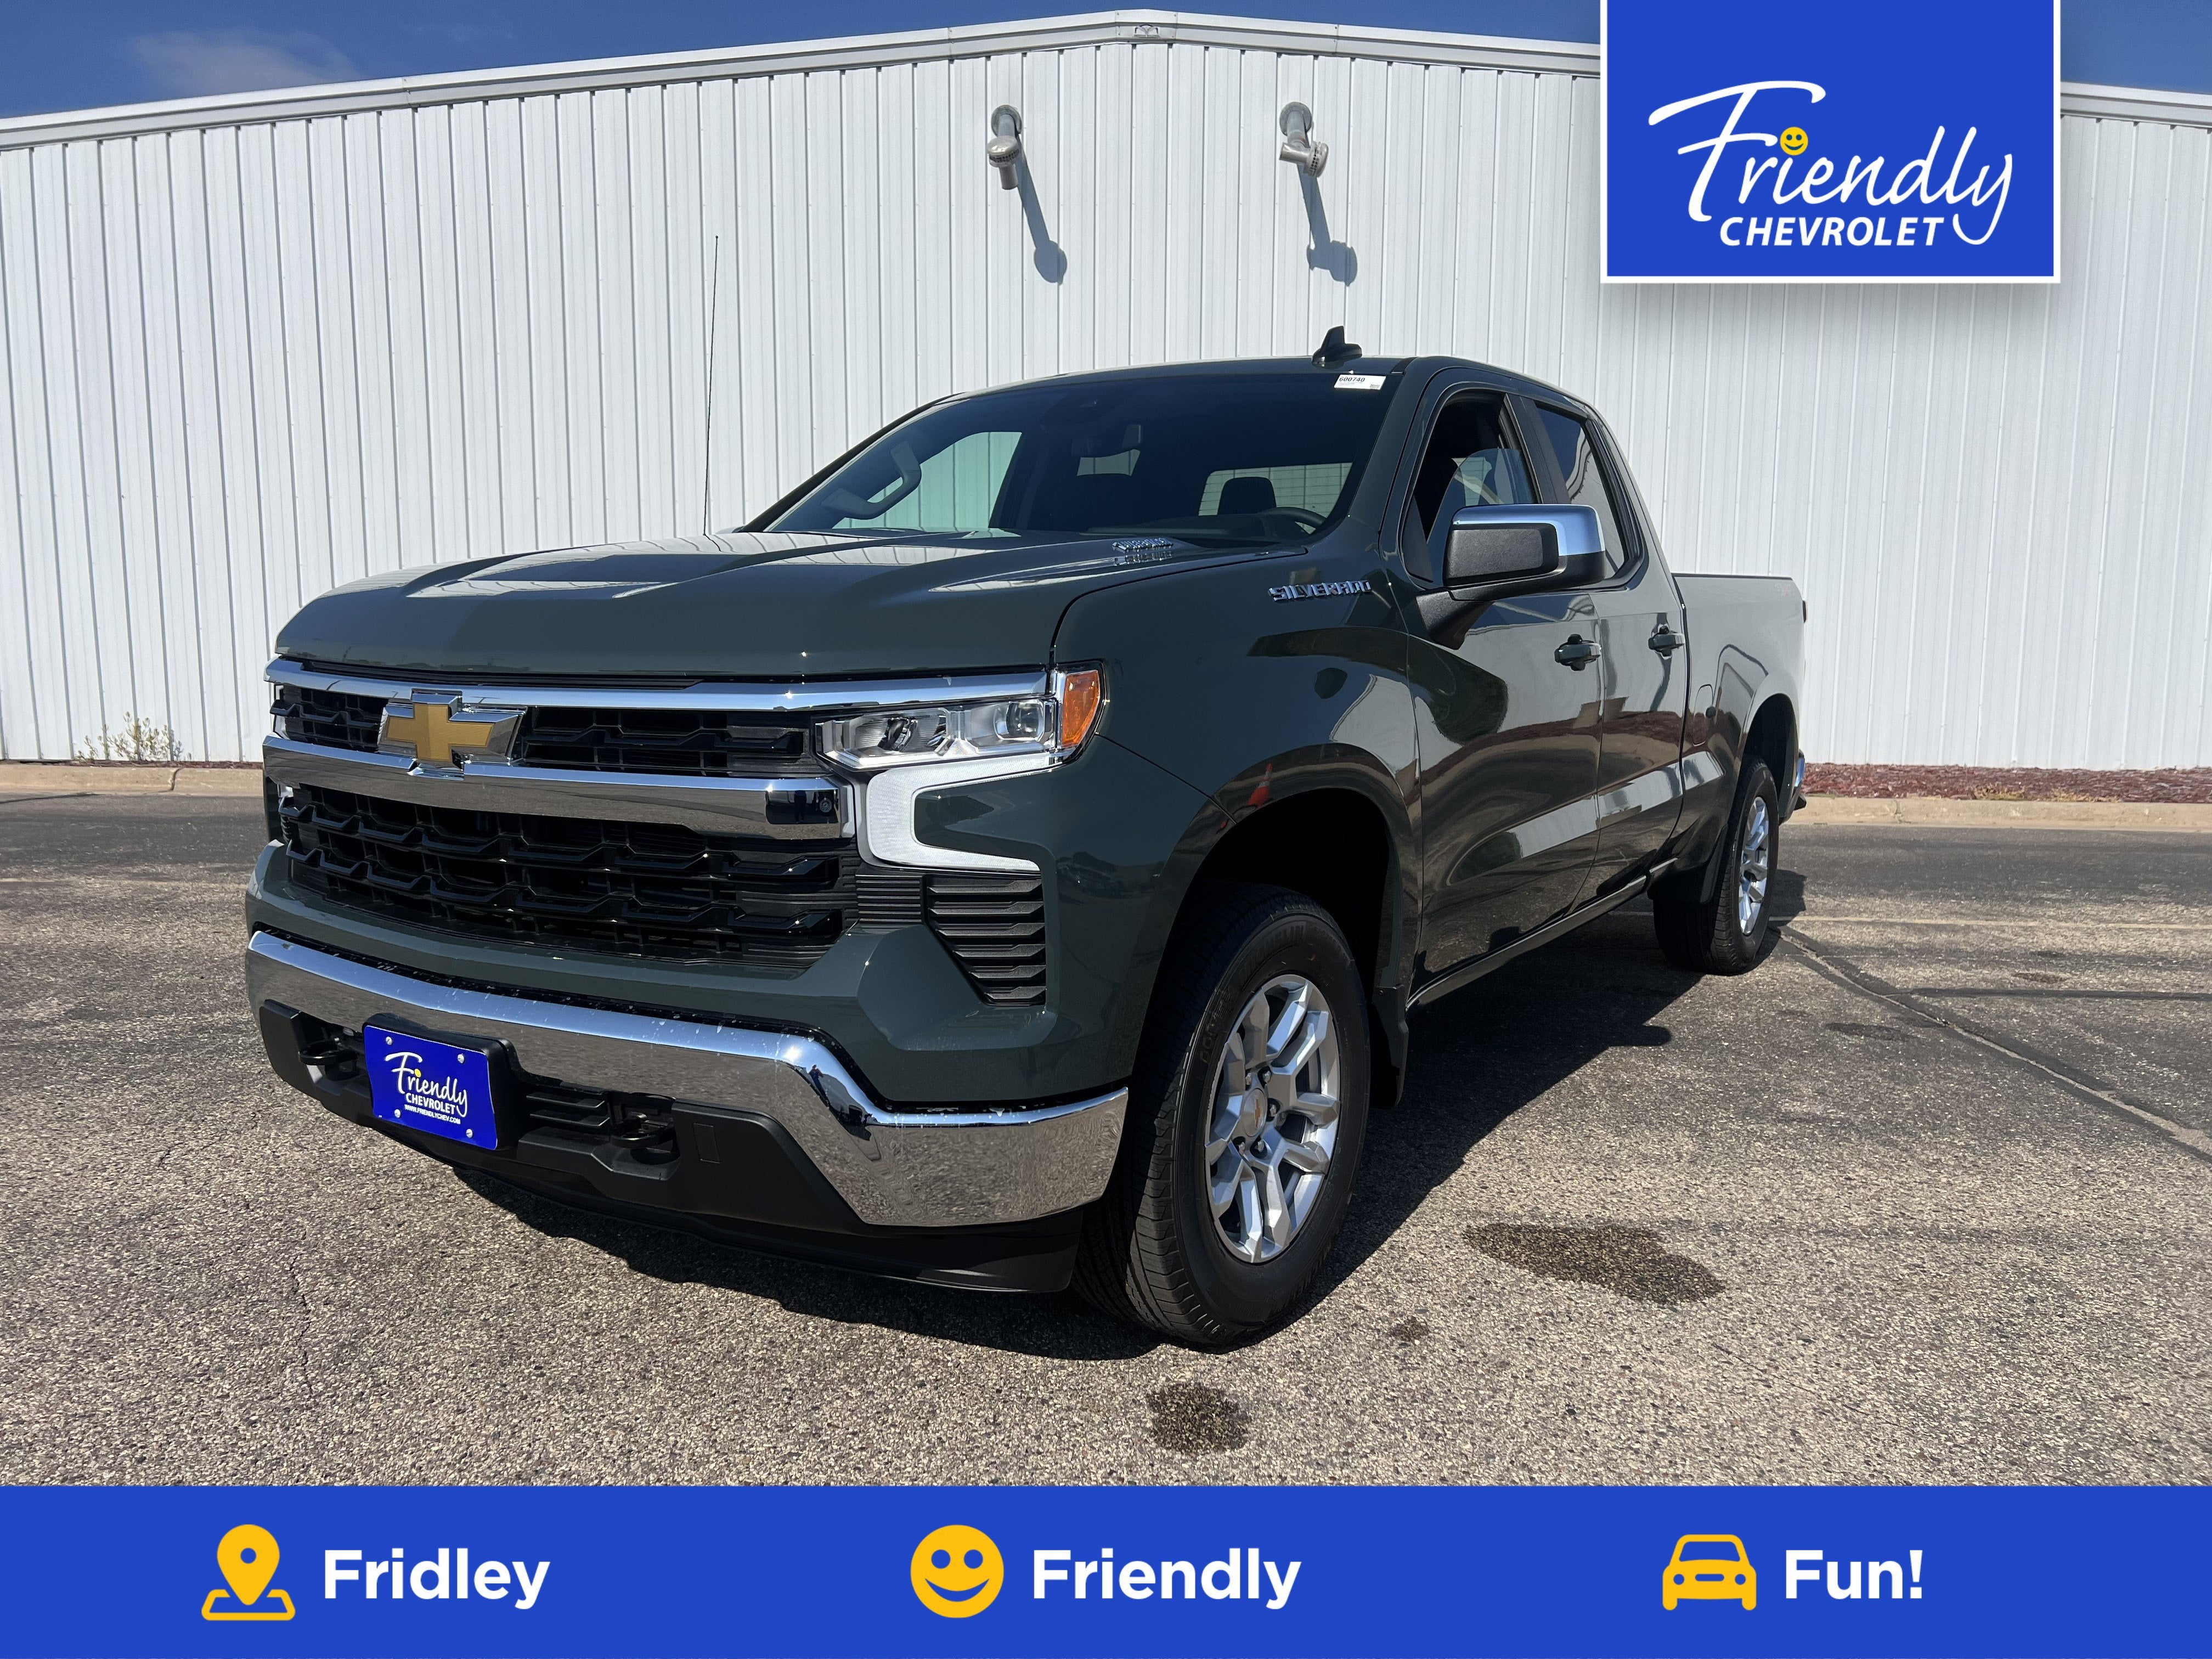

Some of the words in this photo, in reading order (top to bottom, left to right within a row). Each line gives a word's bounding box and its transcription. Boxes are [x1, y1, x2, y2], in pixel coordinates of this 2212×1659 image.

[1268, 579, 1372, 602] SILVERADO
[385, 1052, 467, 1118] Friendly
[405, 1092, 456, 1115] CHEVROLET
